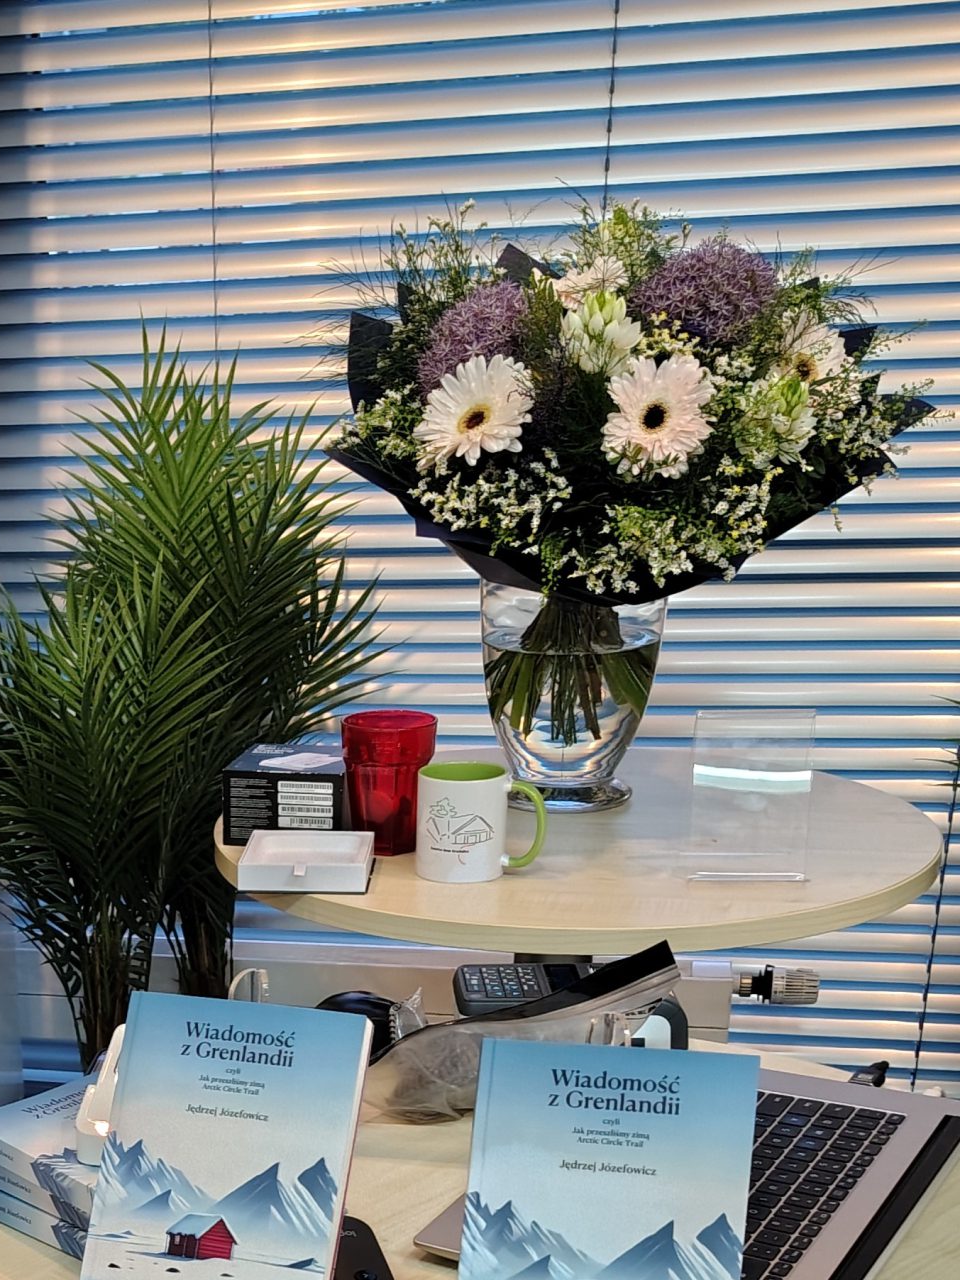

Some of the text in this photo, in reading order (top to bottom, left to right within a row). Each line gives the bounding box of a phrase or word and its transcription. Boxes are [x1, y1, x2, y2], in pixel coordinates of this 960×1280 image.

[186, 1020, 296, 1048] Wiadomość
[180, 1042, 295, 1068] z Grenlandii
[211, 1076, 248, 1087] przeszliśmy
[249, 1081, 265, 1089] zimą
[551, 1068, 681, 1094] Wiadomość
[222, 1085, 242, 1094] Circle
[243, 1087, 260, 1096] Trail
[548, 1090, 681, 1116] z Grenlandii
[185, 1103, 269, 1122] Jędrzej Józefowicz
[602, 1117, 620, 1126] czyli
[571, 1126, 650, 1141] Jak przeszliśmy zimą
[577, 1135, 644, 1148] Arctic Circle Trail
[559, 1159, 657, 1176] Jędrzej Józefowicz
